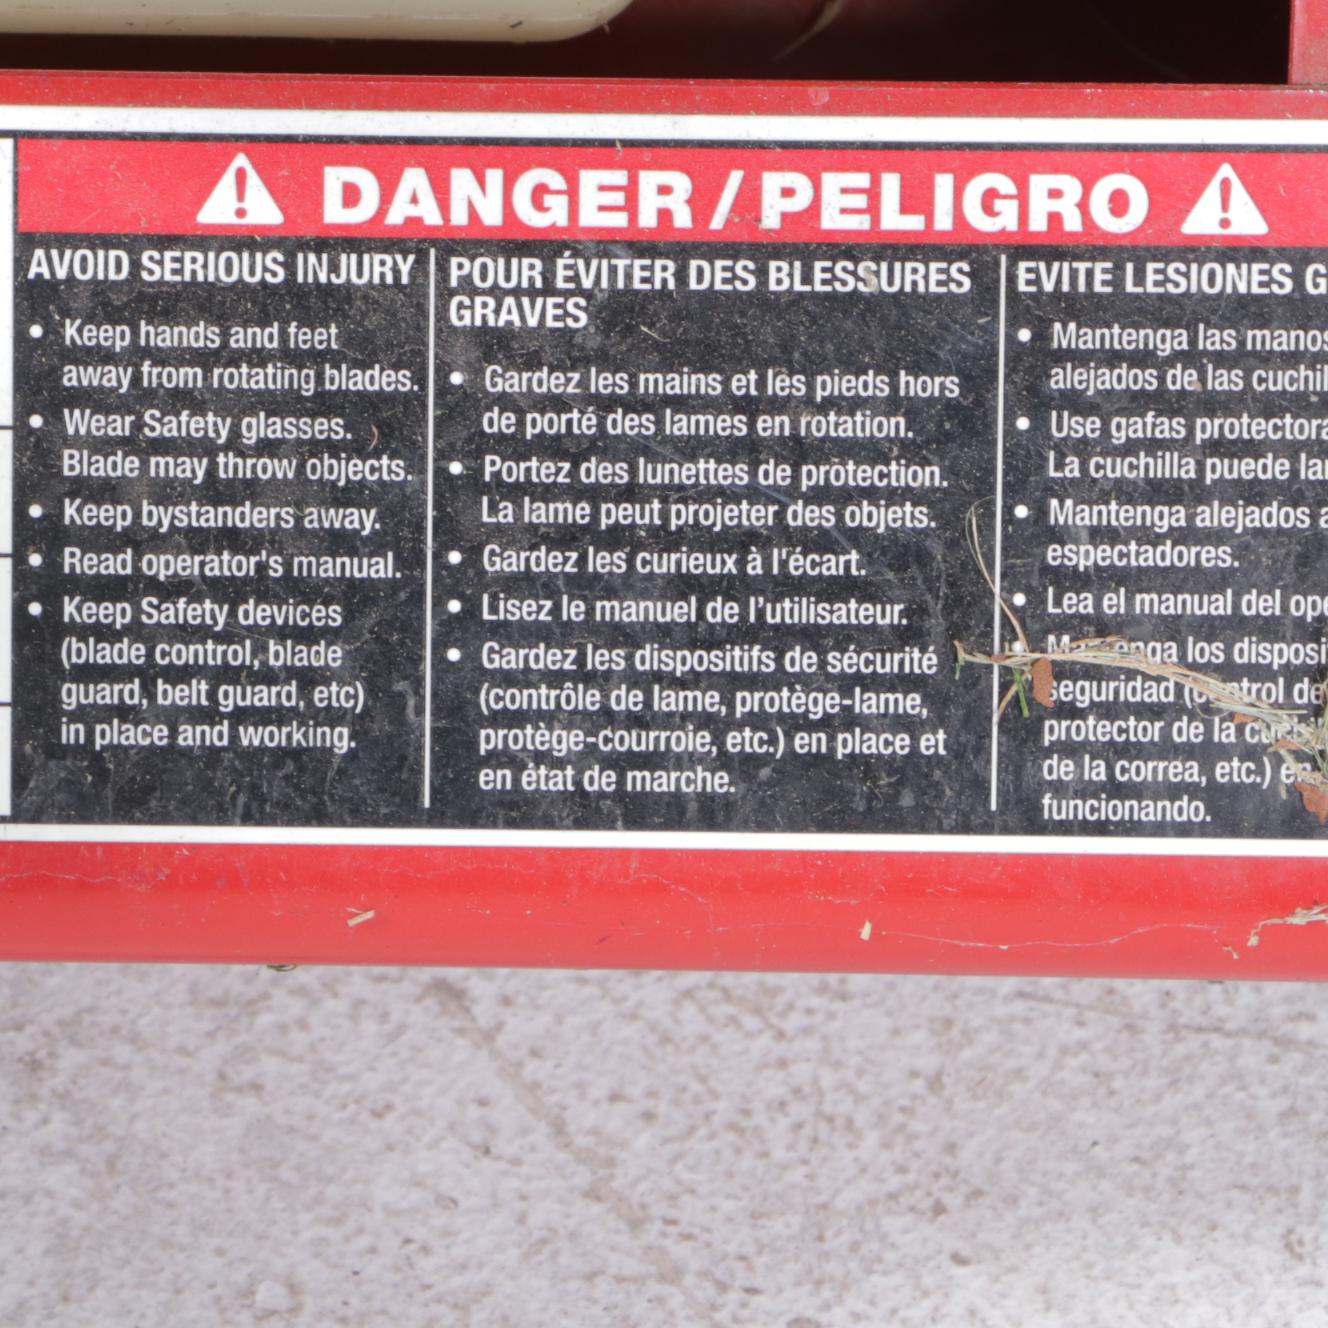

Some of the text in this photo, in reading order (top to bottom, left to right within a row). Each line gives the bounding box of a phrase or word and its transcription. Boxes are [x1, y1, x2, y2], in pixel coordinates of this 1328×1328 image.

[27, 247, 416, 286] AVOID SERIOUS INJURY
[449, 250, 972, 294] POUR ÉVITER DES BLESSURES
[1016, 261, 1113, 293] EVITE
[1125, 262, 1293, 295] LESIONES
[448, 294, 588, 329] GRAVES
[64, 318, 339, 353] Keep hands and feet
[1052, 321, 1189, 357] Mantenga
[1197, 323, 1237, 351] las
[62, 360, 419, 396] away from rotating blades.
[484, 364, 960, 402] Gardez les mains et les pieds hors
[1050, 362, 1158, 396] alejados
[1166, 363, 1198, 391] de
[1207, 363, 1244, 391] las
[63, 408, 352, 445] Wear Safety glasses.
[482, 406, 914, 440] de porté des lames en rotation.
[1050, 410, 1102, 439] Use
[1110, 410, 1187, 445] gafas
[62, 448, 414, 487] Blade may throw objects.
[484, 454, 948, 492] Portez des lunettes de protection.
[1048, 450, 1080, 478] La
[1089, 451, 1196, 479] cuchilla
[1205, 452, 1290, 485] puede
[64, 498, 380, 536] Keep bystanders away.
[481, 495, 937, 534] La lame peut projeter des objets.
[1049, 498, 1187, 533] Mantenga
[1195, 499, 1311, 534] alejados
[63, 546, 402, 582] Read operator's manual.
[482, 543, 867, 577] Gardez les curieux à l'écart.
[1046, 539, 1240, 572] espectadores.
[64, 596, 342, 631] Keep Safety devices
[482, 593, 907, 625] Lisez le manuel de l’utilisateur.
[1047, 586, 1095, 614] Lea
[1102, 586, 1126, 615] el
[1134, 587, 1233, 616] manual
[1240, 588, 1282, 617] del
[61, 636, 343, 671] (blade control, blade
[481, 641, 938, 677] Gardez les dispositifs de sécurité
[1187, 635, 1225, 664] los
[61, 678, 364, 713] guard, belt guard, etc)
[479, 682, 928, 720] (contrôle de lame, protège-lame,
[1048, 675, 1177, 708] seguridad
[61, 716, 356, 755] in place and working.
[480, 722, 946, 759] protège-courroie, etc.) en place et
[1043, 714, 1165, 747] protector
[1171, 715, 1205, 743] de
[1213, 715, 1237, 744] la
[479, 763, 735, 793] en état de marche.
[1042, 753, 1075, 781] de
[1083, 754, 1107, 782] la
[1114, 759, 1207, 787] correa,
[1214, 756, 1272, 790] etc.)
[1041, 792, 1212, 823] funcionando.
